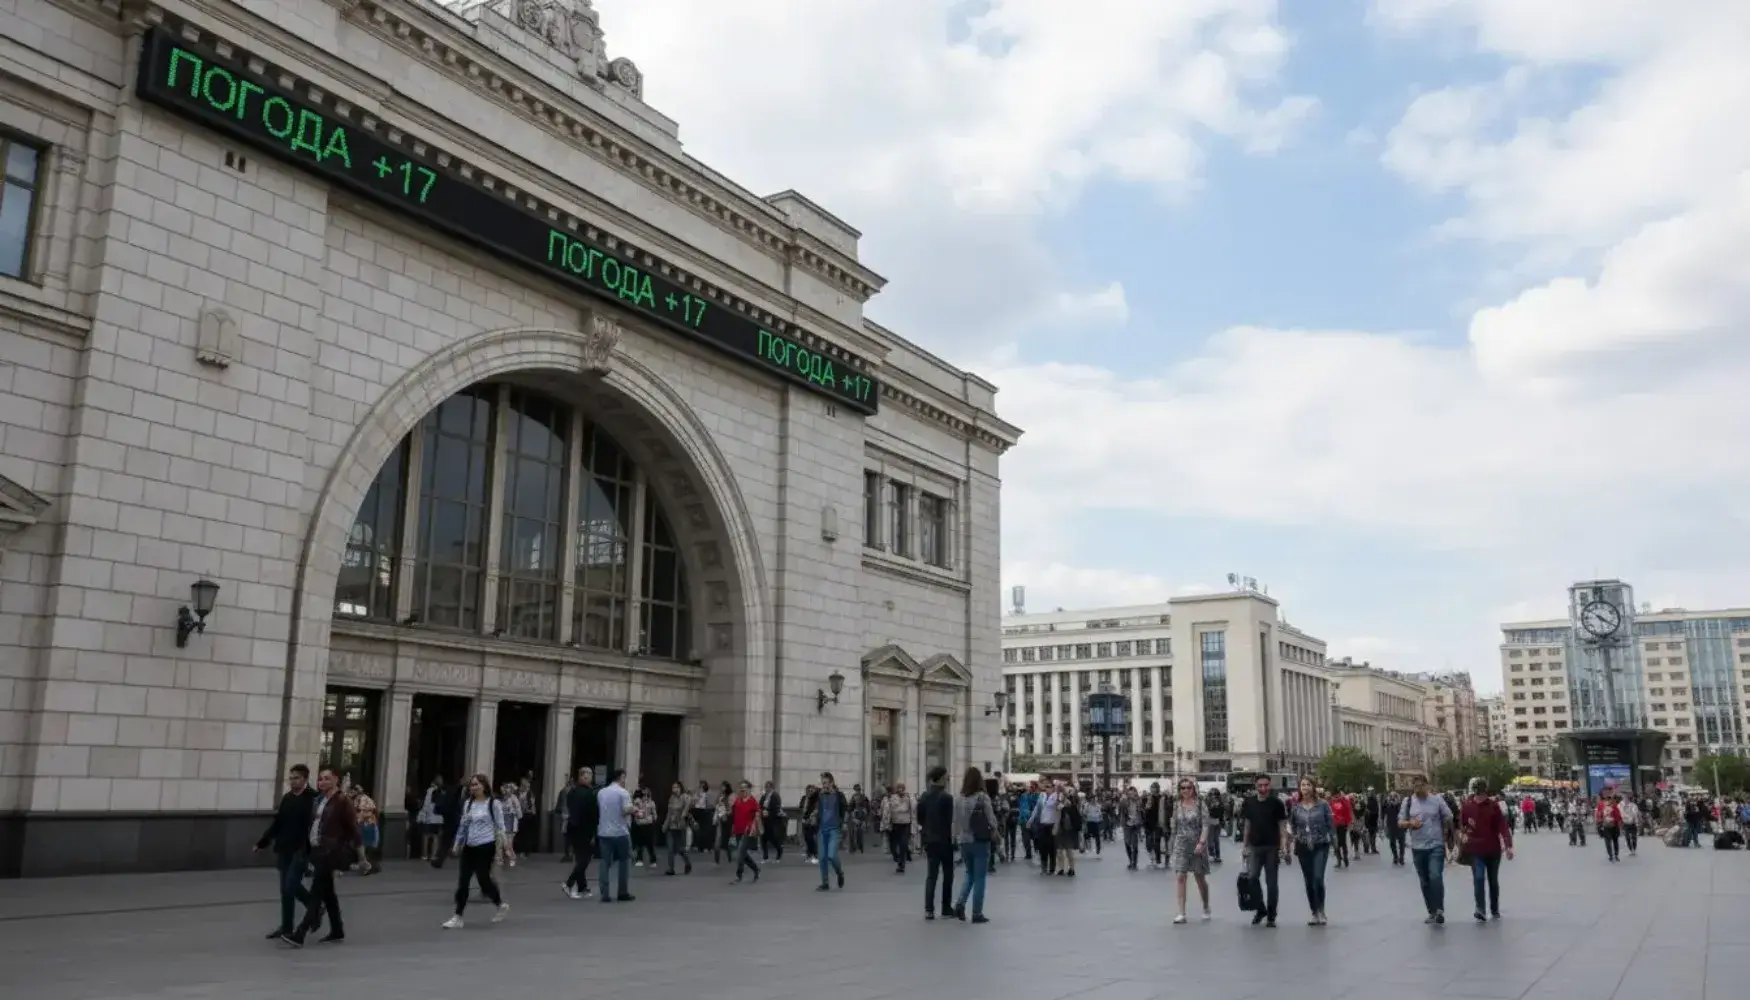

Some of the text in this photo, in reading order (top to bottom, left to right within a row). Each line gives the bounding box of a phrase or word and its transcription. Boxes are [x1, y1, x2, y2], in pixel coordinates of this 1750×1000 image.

[167, 47, 437, 203] ПОГОДА +17
[549, 230, 706, 326] ПОГОДА +17
[758, 331, 871, 401] ПОГОДА +17
